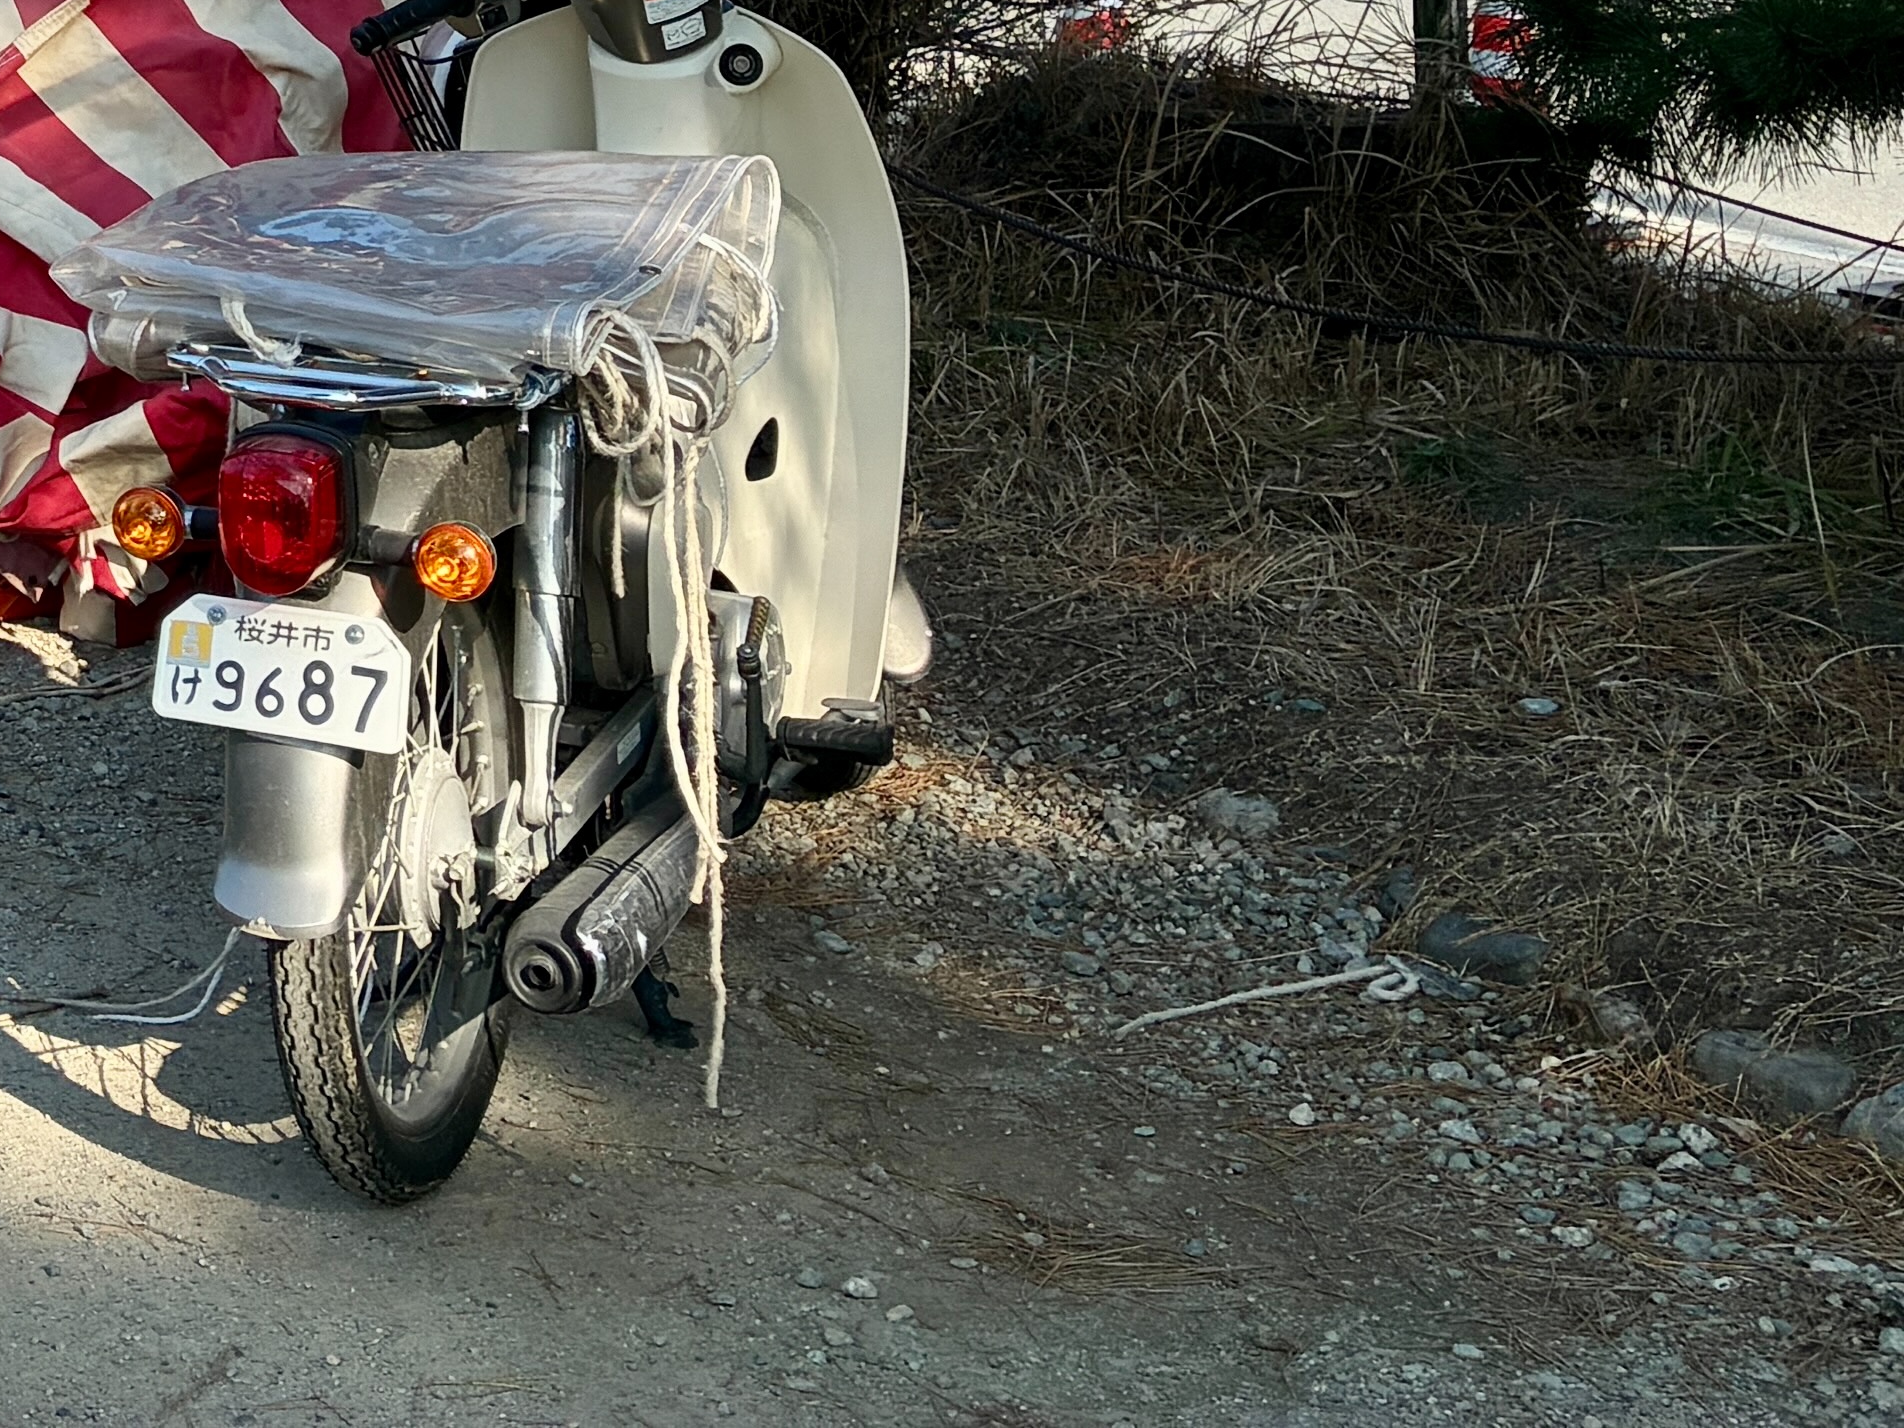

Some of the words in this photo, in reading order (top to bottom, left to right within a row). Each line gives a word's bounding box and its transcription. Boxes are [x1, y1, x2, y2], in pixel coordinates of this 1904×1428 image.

[234, 615, 334, 652] 桜井市
[171, 665, 202, 704] け
[212, 659, 388, 733] 9687
